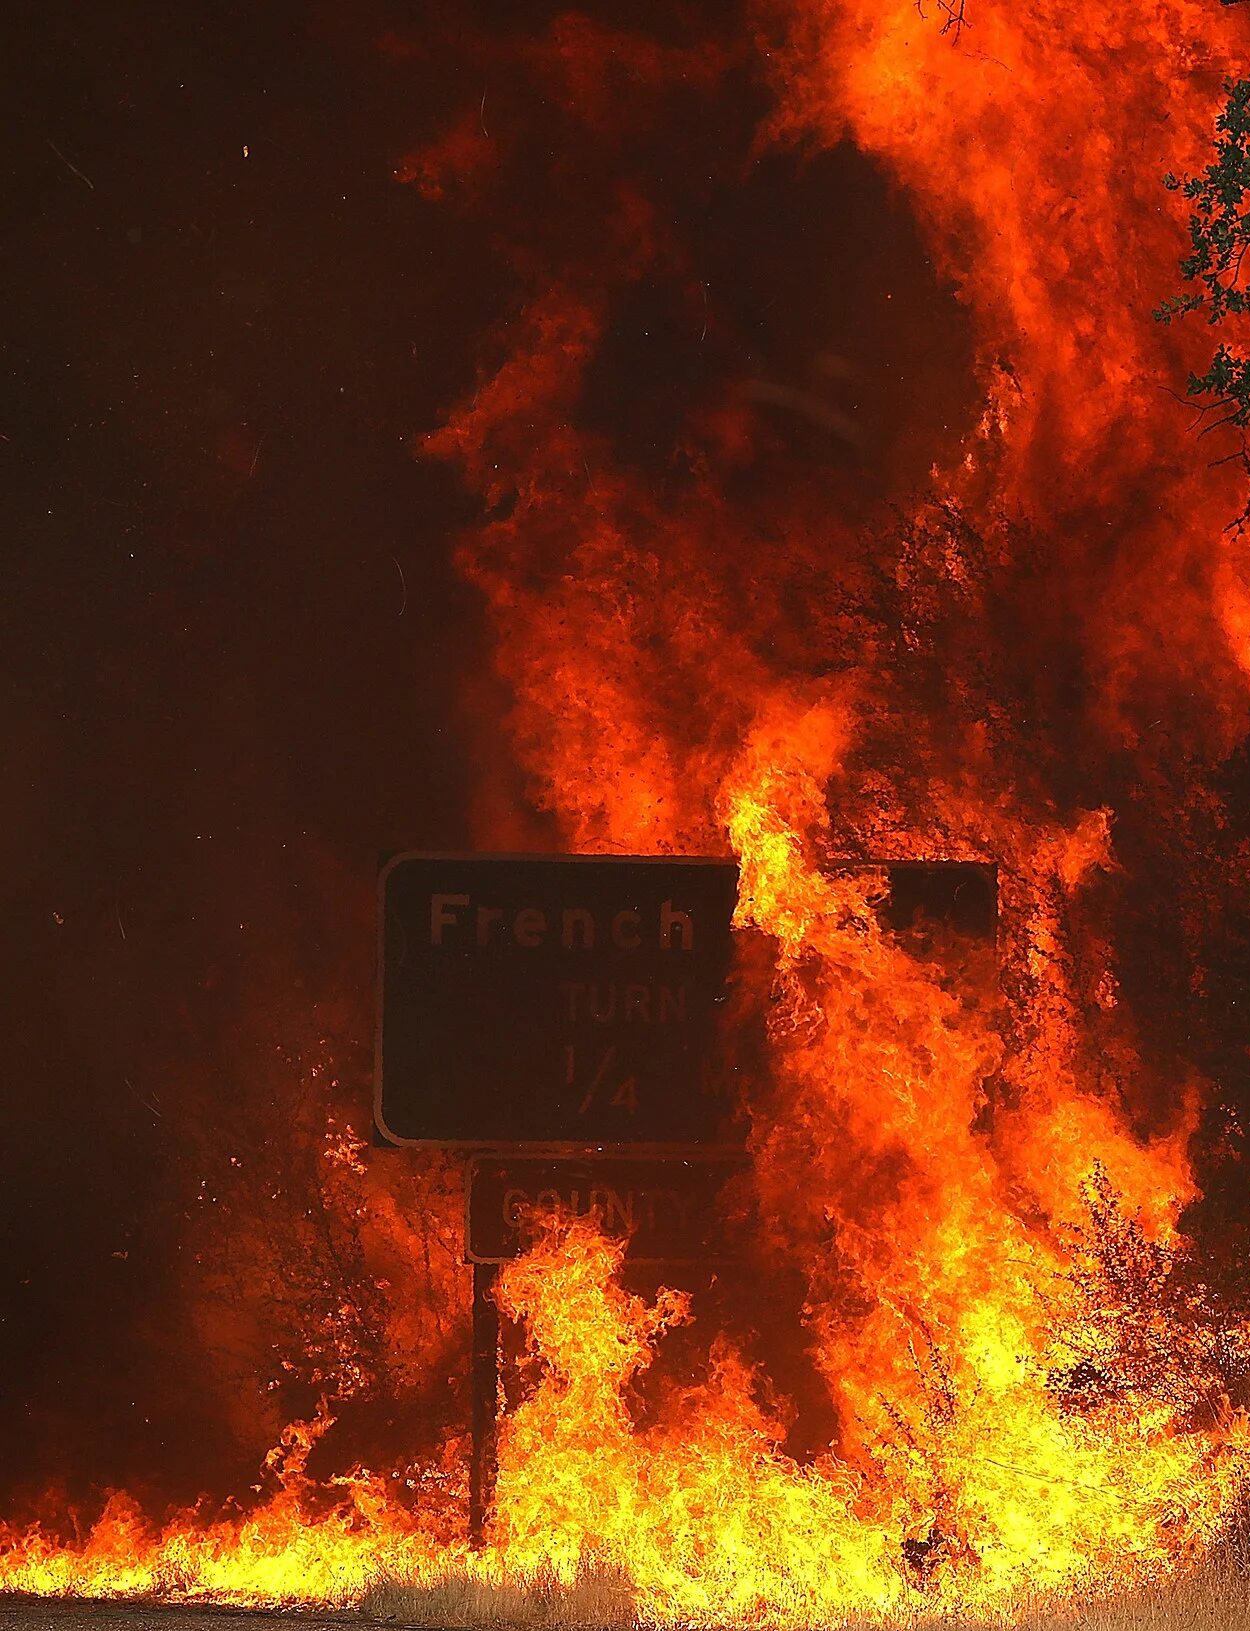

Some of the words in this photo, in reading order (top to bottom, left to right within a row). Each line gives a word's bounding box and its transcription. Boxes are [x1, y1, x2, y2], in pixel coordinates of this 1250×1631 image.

[430, 893, 694, 950] French
[558, 981, 687, 1023] TURN
[563, 1045, 640, 1115] 1/4
